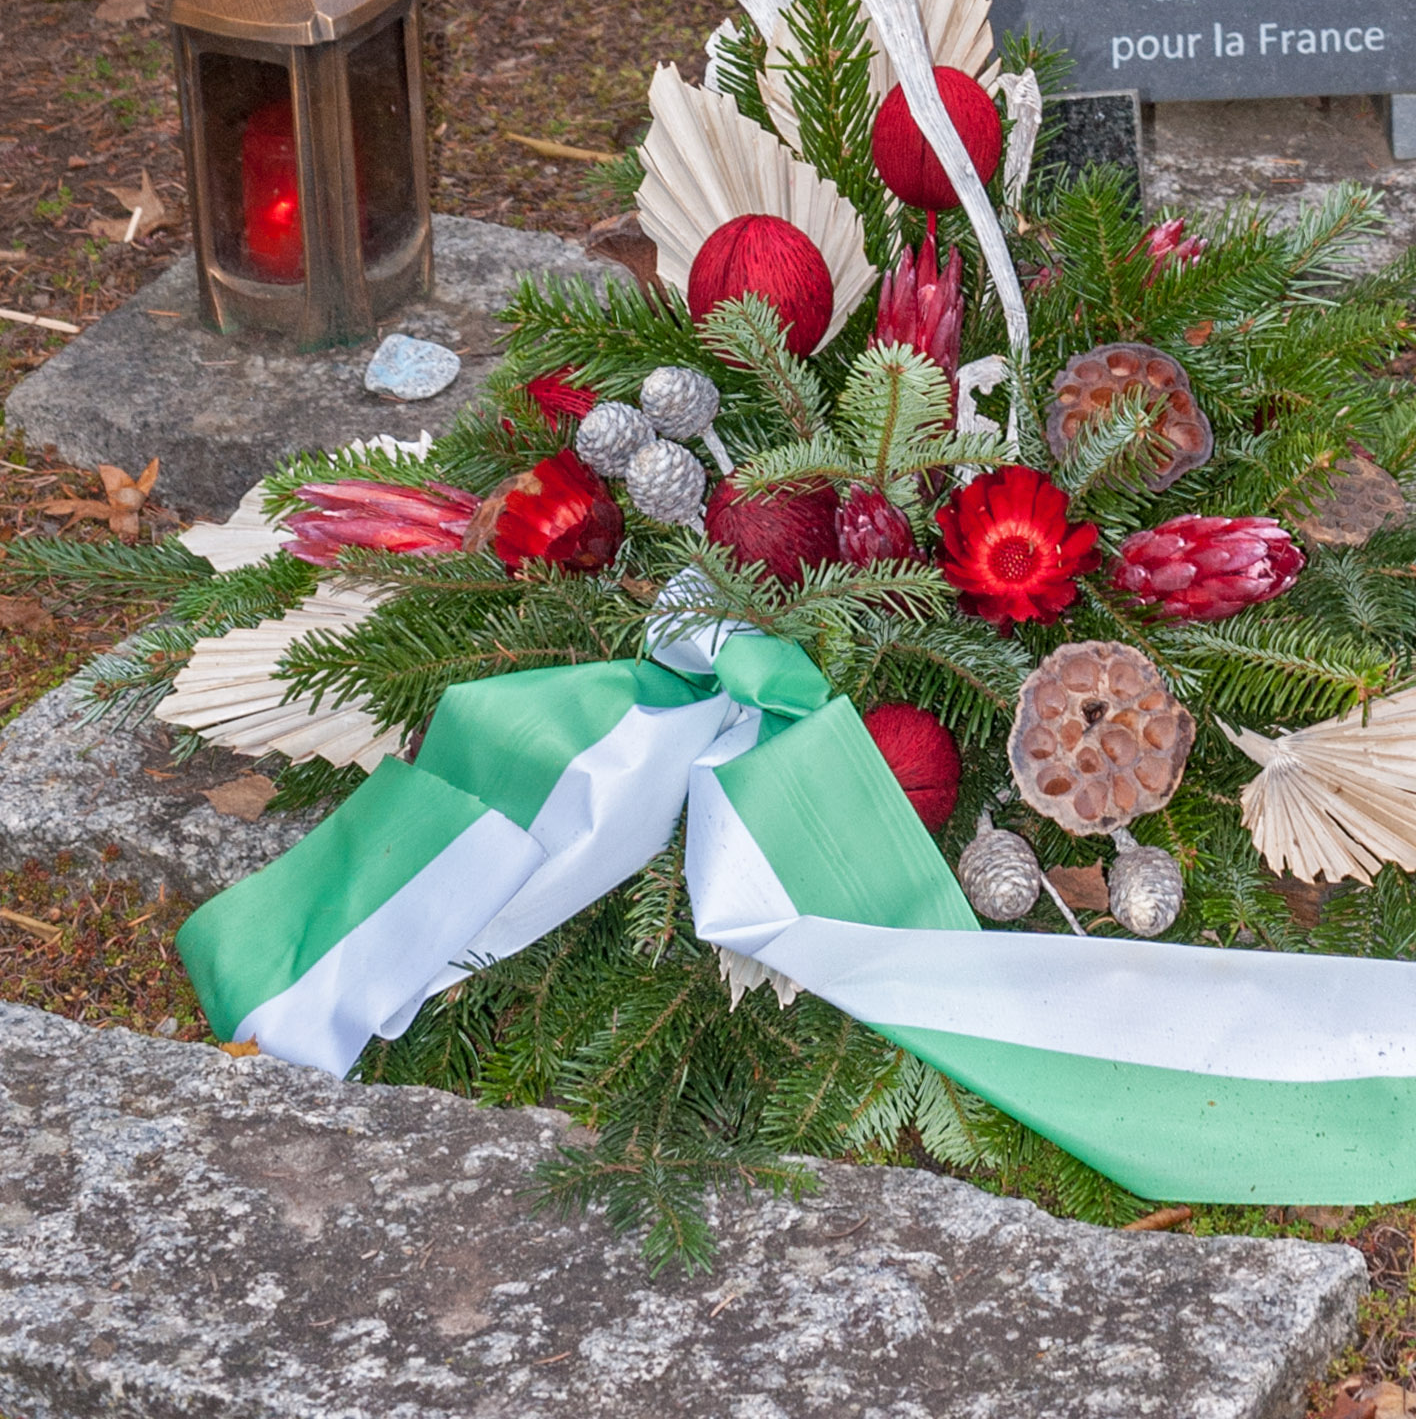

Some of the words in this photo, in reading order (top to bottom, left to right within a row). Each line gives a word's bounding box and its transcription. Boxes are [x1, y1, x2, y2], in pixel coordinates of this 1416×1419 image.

[1111, 32, 1201, 69] pour
[1213, 23, 1246, 58] la
[1259, 22, 1386, 56] France
